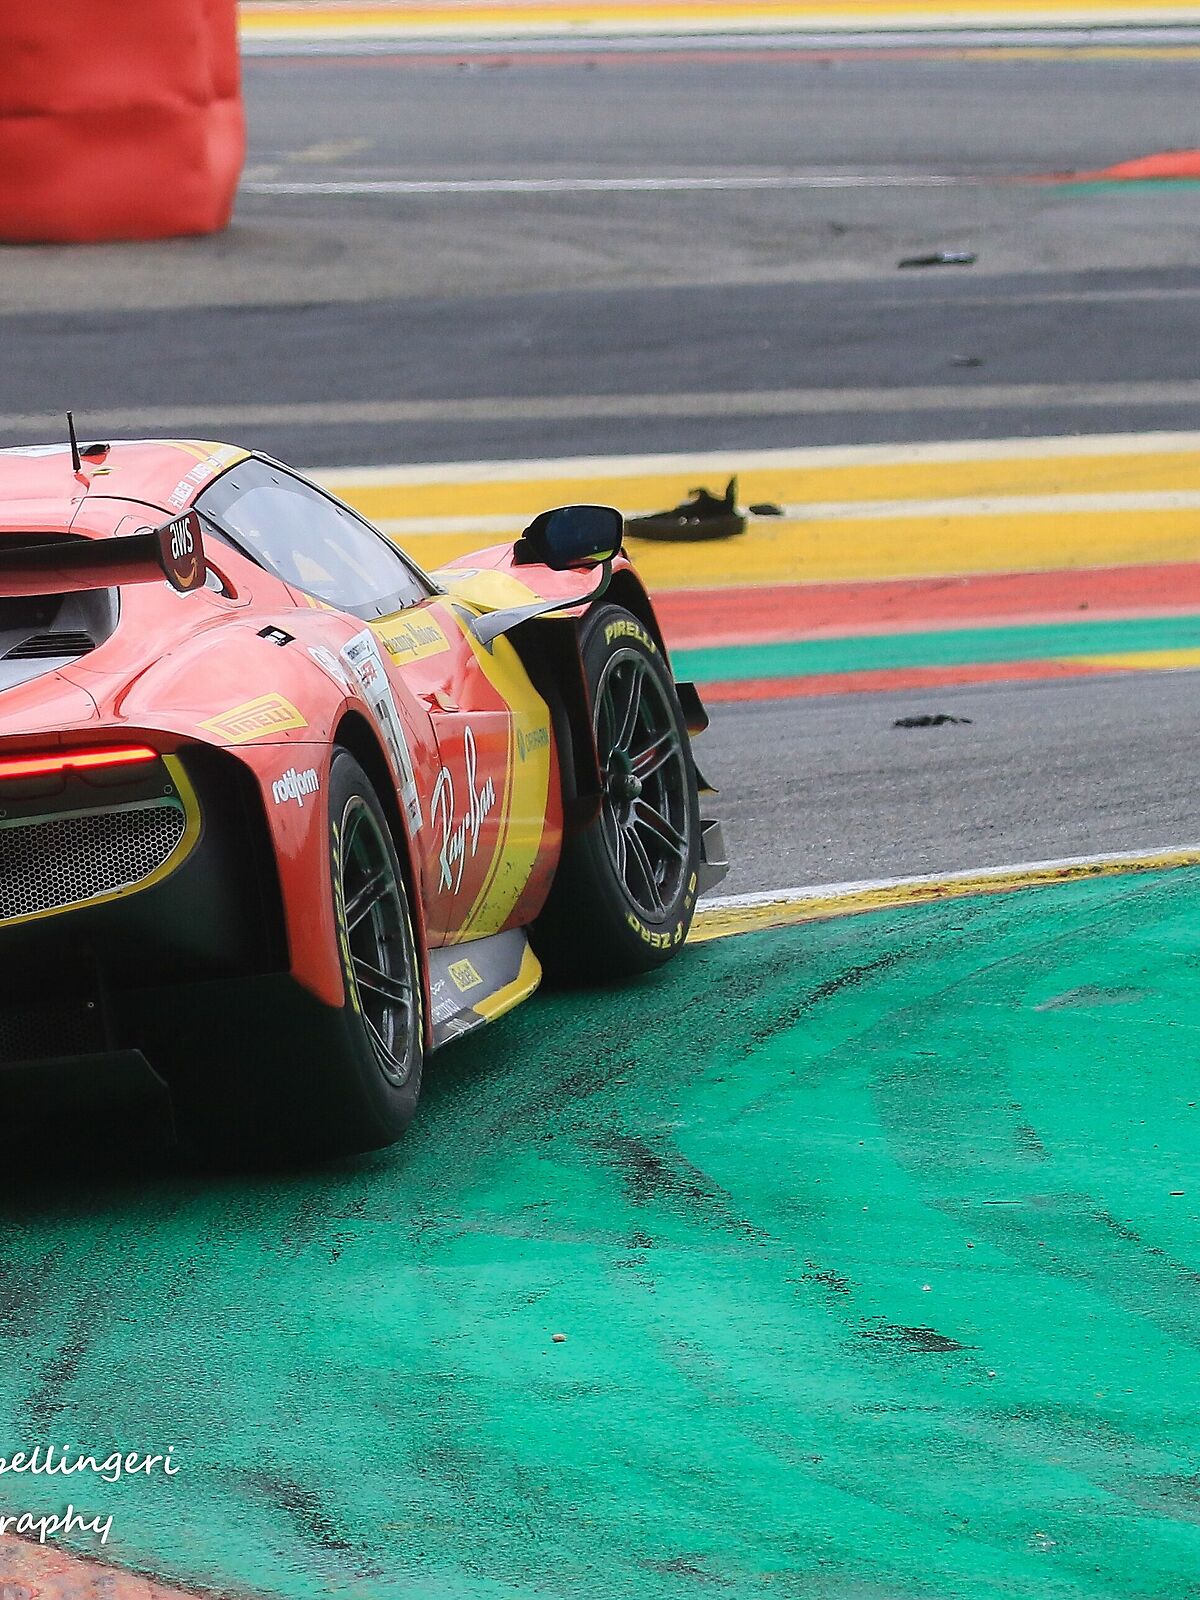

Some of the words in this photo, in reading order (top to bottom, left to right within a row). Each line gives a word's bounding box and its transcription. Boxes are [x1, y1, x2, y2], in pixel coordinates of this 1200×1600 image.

[169, 517, 194, 560] aws
[604, 619, 658, 655] PIRELLI
[271, 767, 321, 808] rotiform
[430, 725, 497, 896] Ray-Ban
[626, 911, 672, 950] ZERO
